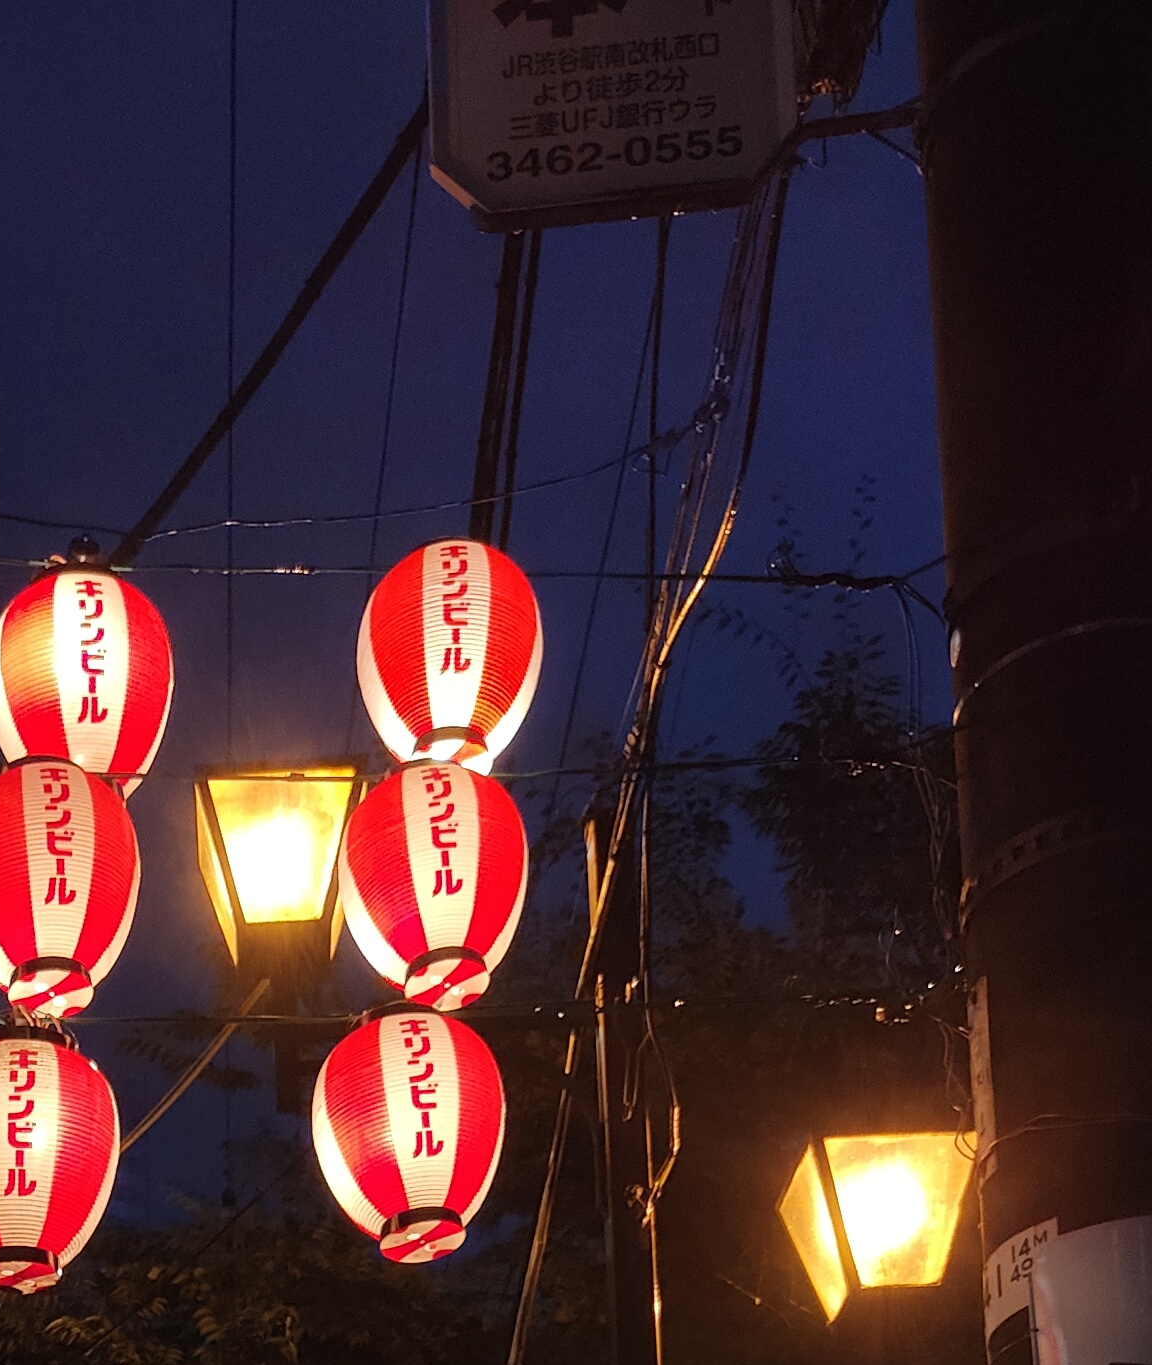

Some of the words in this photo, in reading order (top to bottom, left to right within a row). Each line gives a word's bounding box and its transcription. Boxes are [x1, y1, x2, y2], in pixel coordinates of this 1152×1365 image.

[502, 32, 721, 80] JR渋谷駅南改札西口
[509, 94, 719, 141] 三菱UFJ銀行ウラ
[533, 66, 690, 107] より徒歩2分
[486, 125, 745, 183] 3462-0555
[74, 579, 109, 725] キリンビール
[439, 545, 471, 675] キリンビール
[39, 766, 77, 906] キリンビール
[420, 766, 463, 897] キリンビール
[4, 1049, 38, 1197] キリンビール
[399, 1019, 444, 1159] キリンビール
